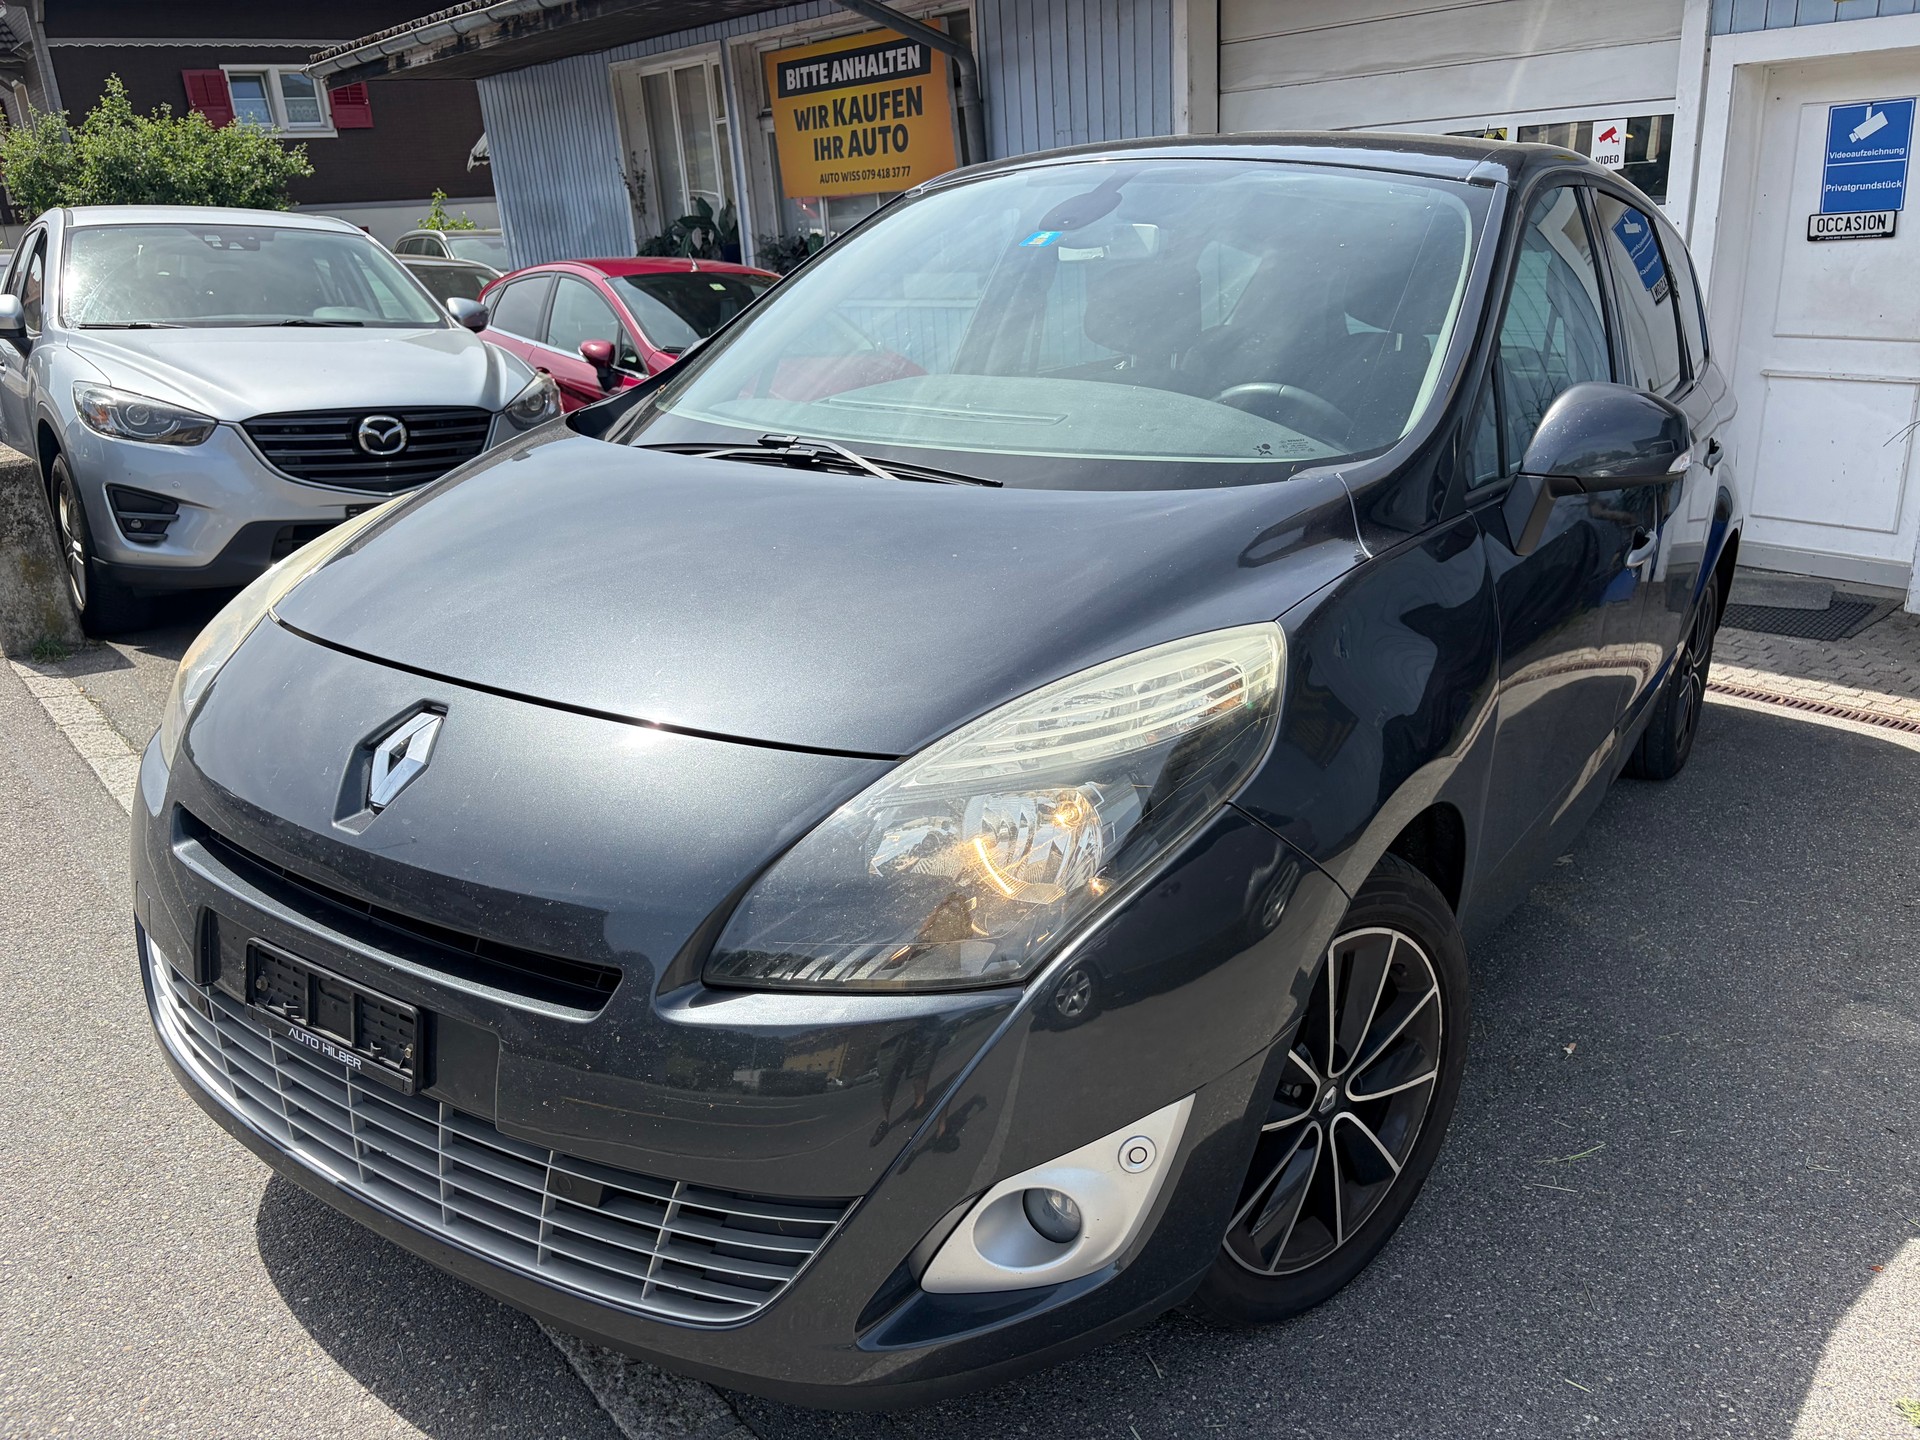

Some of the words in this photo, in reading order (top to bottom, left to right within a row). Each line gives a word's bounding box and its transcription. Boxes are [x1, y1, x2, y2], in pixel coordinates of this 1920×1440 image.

[785, 61, 829, 90] BITTE
[831, 44, 921, 83] ANHALTEN
[793, 104, 830, 132] WIR
[832, 85, 923, 127] KAUFEN
[813, 135, 844, 162] IHR
[847, 124, 909, 159] AUTO
[1829, 147, 1905, 159] Videoaufzeichnung
[1595, 154, 1620, 165] VIDEO
[819, 172, 840, 185] AUTO
[841, 169, 861, 182] WISS
[861, 168, 876, 181] 079
[876, 167, 891, 179] 418
[1825, 180, 1902, 193] Privatgrundstück
[1816, 213, 1887, 233] OCCASION
[288, 1027, 319, 1050] AUTO
[322, 1042, 362, 1071] HILBER
